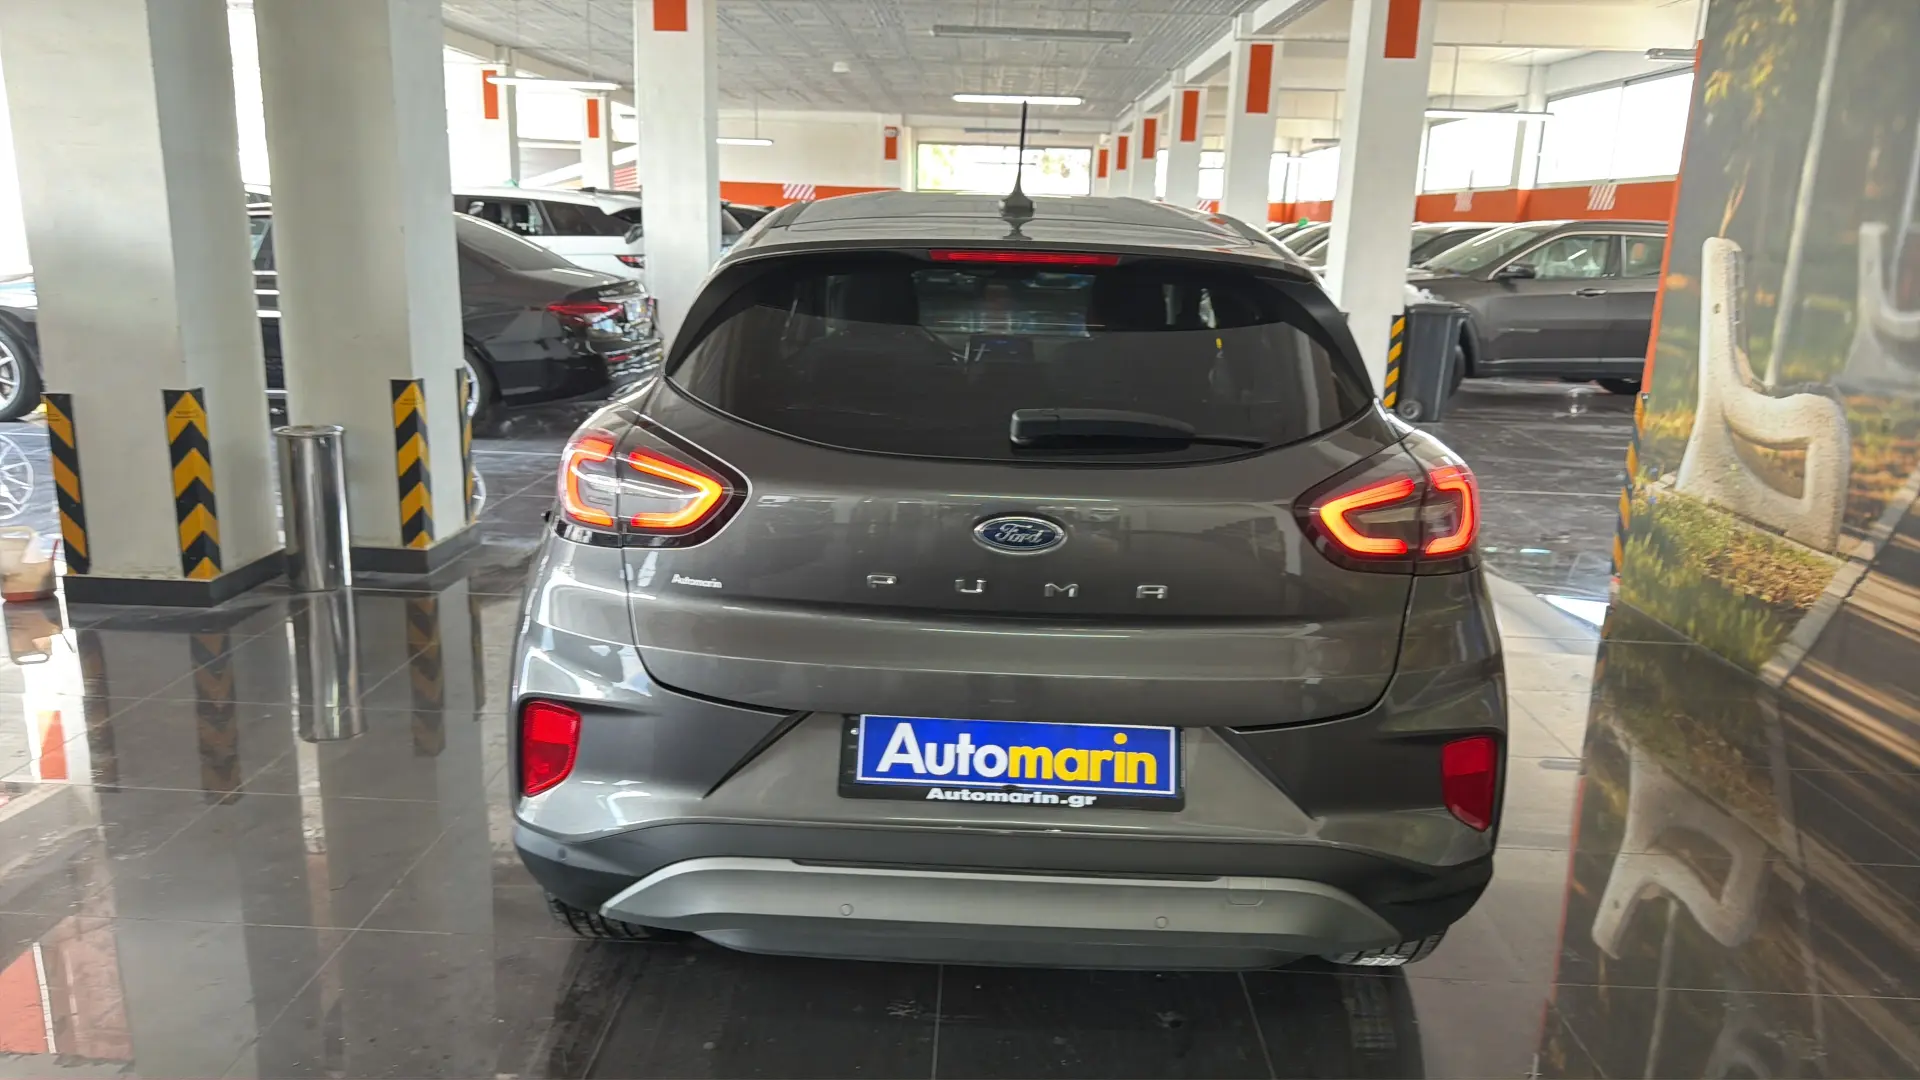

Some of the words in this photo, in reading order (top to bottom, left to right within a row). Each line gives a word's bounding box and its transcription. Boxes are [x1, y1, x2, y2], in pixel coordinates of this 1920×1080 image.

[994, 522, 1045, 543] Ford
[866, 573, 1169, 600] PUMA
[876, 722, 1157, 785] Automarin
[925, 787, 1098, 808] Automarin.gr
